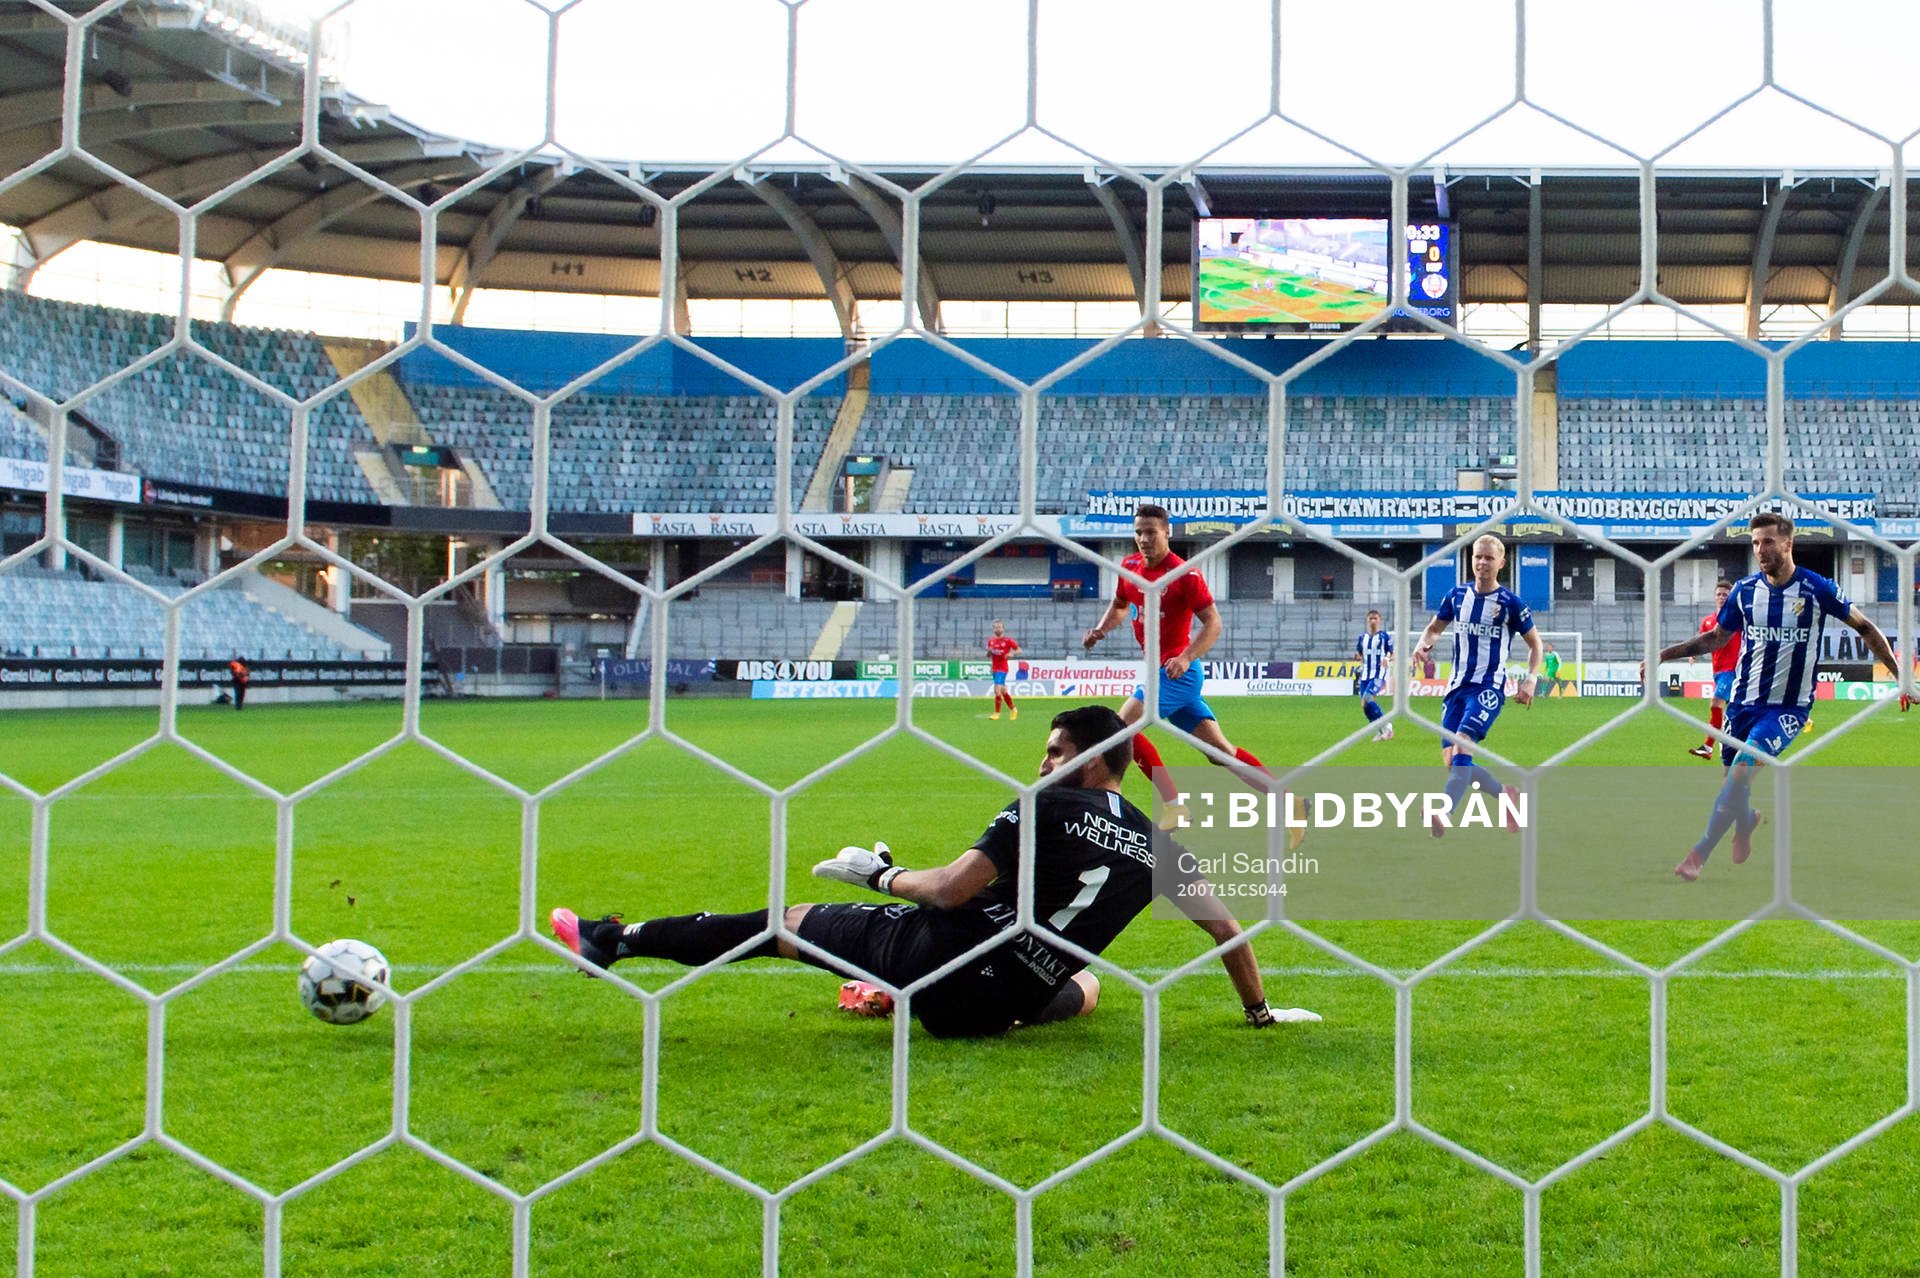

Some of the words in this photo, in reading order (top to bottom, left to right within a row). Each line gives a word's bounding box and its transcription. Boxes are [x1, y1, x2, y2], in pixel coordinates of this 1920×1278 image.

[551, 261, 585, 276] H1
[734, 267, 773, 282] H2
[1018, 270, 1054, 284] H3
[64, 472, 91, 491] igab
[1275, 494, 1325, 518] ÖGT
[1333, 496, 1457, 518] KAMRATER
[651, 521, 697, 535] RASTA
[710, 522, 756, 535] RASTA
[793, 522, 828, 536] ASTA
[841, 522, 887, 535] RASTA
[918, 523, 964, 536] RASTA
[977, 523, 1016, 536] RAST
[1454, 620, 1501, 639] SERNEKE
[1747, 624, 1810, 642] SERNEKE
[866, 664, 893, 675] MCR
[915, 664, 942, 675] MCR
[964, 663, 992, 675] MCR
[771, 681, 879, 698] EFFEKTIV
[1083, 811, 1148, 848] NORDIC
[1064, 821, 1158, 869] WELLNESS
[1048, 864, 1111, 932] 1
